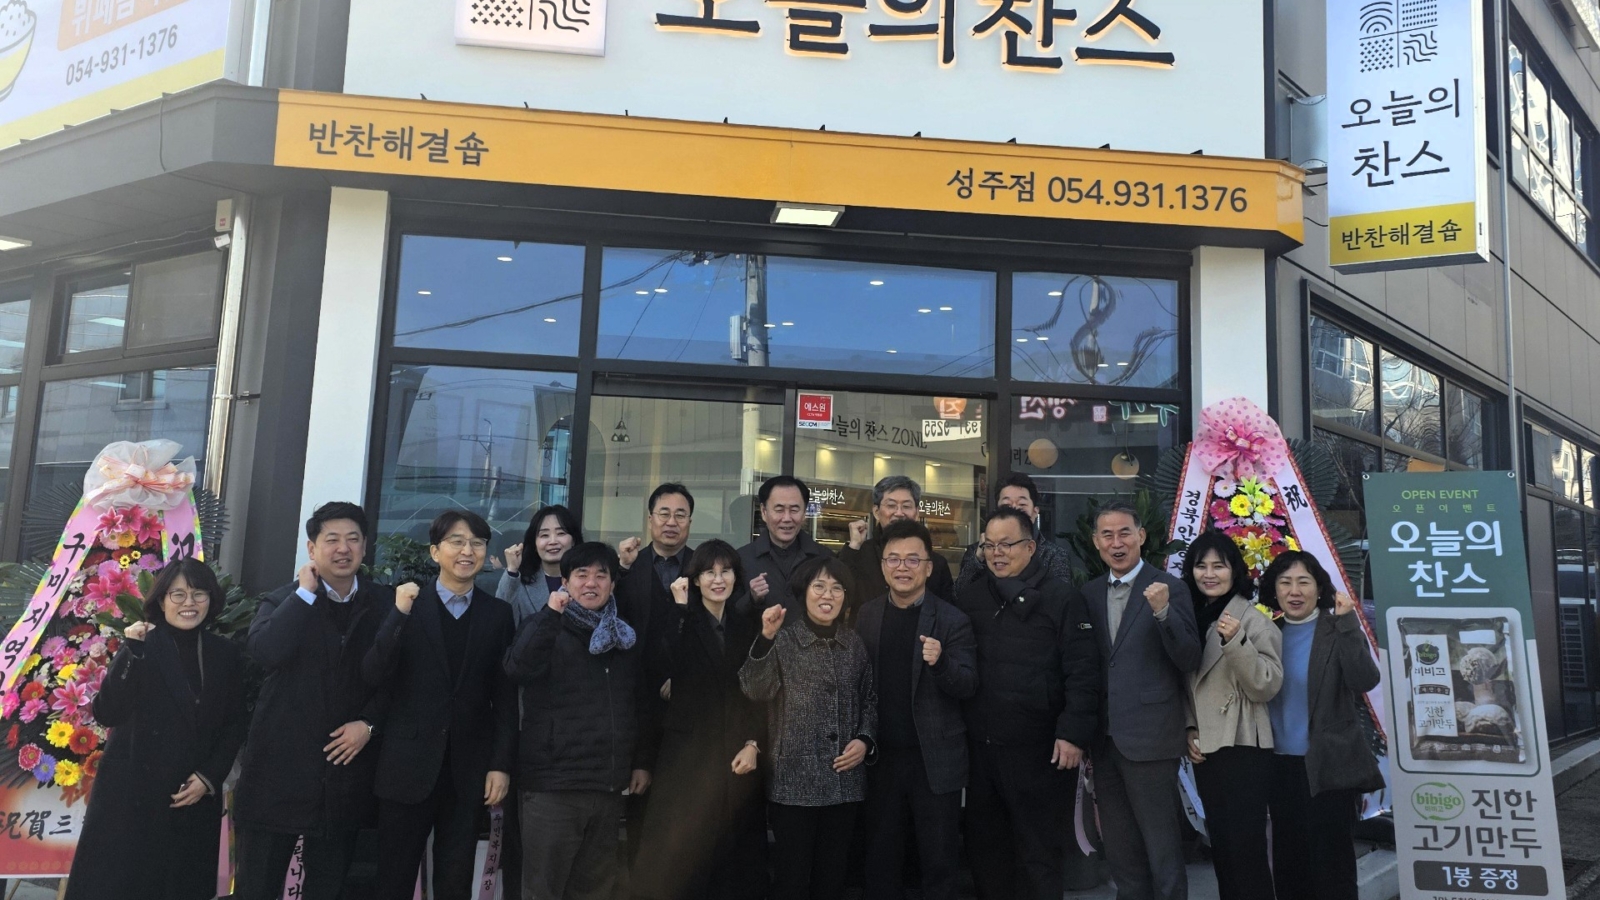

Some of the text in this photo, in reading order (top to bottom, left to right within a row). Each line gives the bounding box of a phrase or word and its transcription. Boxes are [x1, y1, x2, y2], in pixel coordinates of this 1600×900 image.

[66, 24, 178, 86] 054-931-1376
[1341, 78, 1460, 129] 오늘의
[309, 120, 489, 166] 반찬해결숍
[1351, 141, 1450, 188] 찬스
[947, 168, 1248, 213] 성주점 054.931.1376
[1341, 219, 1462, 250] 반찬해결숍
[865, 421, 888, 441] 찬스
[919, 500, 951, 516] 오늘의찬스
[1283, 485, 1308, 512] 祝
[1402, 490, 1479, 499] OPEN EVENT
[1388, 520, 1503, 556] 오늘의
[1408, 560, 1490, 597] 찬스
[1419, 719, 1454, 729] 고기만두
[1425, 706, 1444, 717] 진한
[1416, 793, 1461, 809] bibigo
[1472, 789, 1537, 821] 진한
[0, 810, 85, 841] 祝賀三
[1413, 825, 1542, 859] 고기만두
[1442, 866, 1519, 890] 1봉 증정
